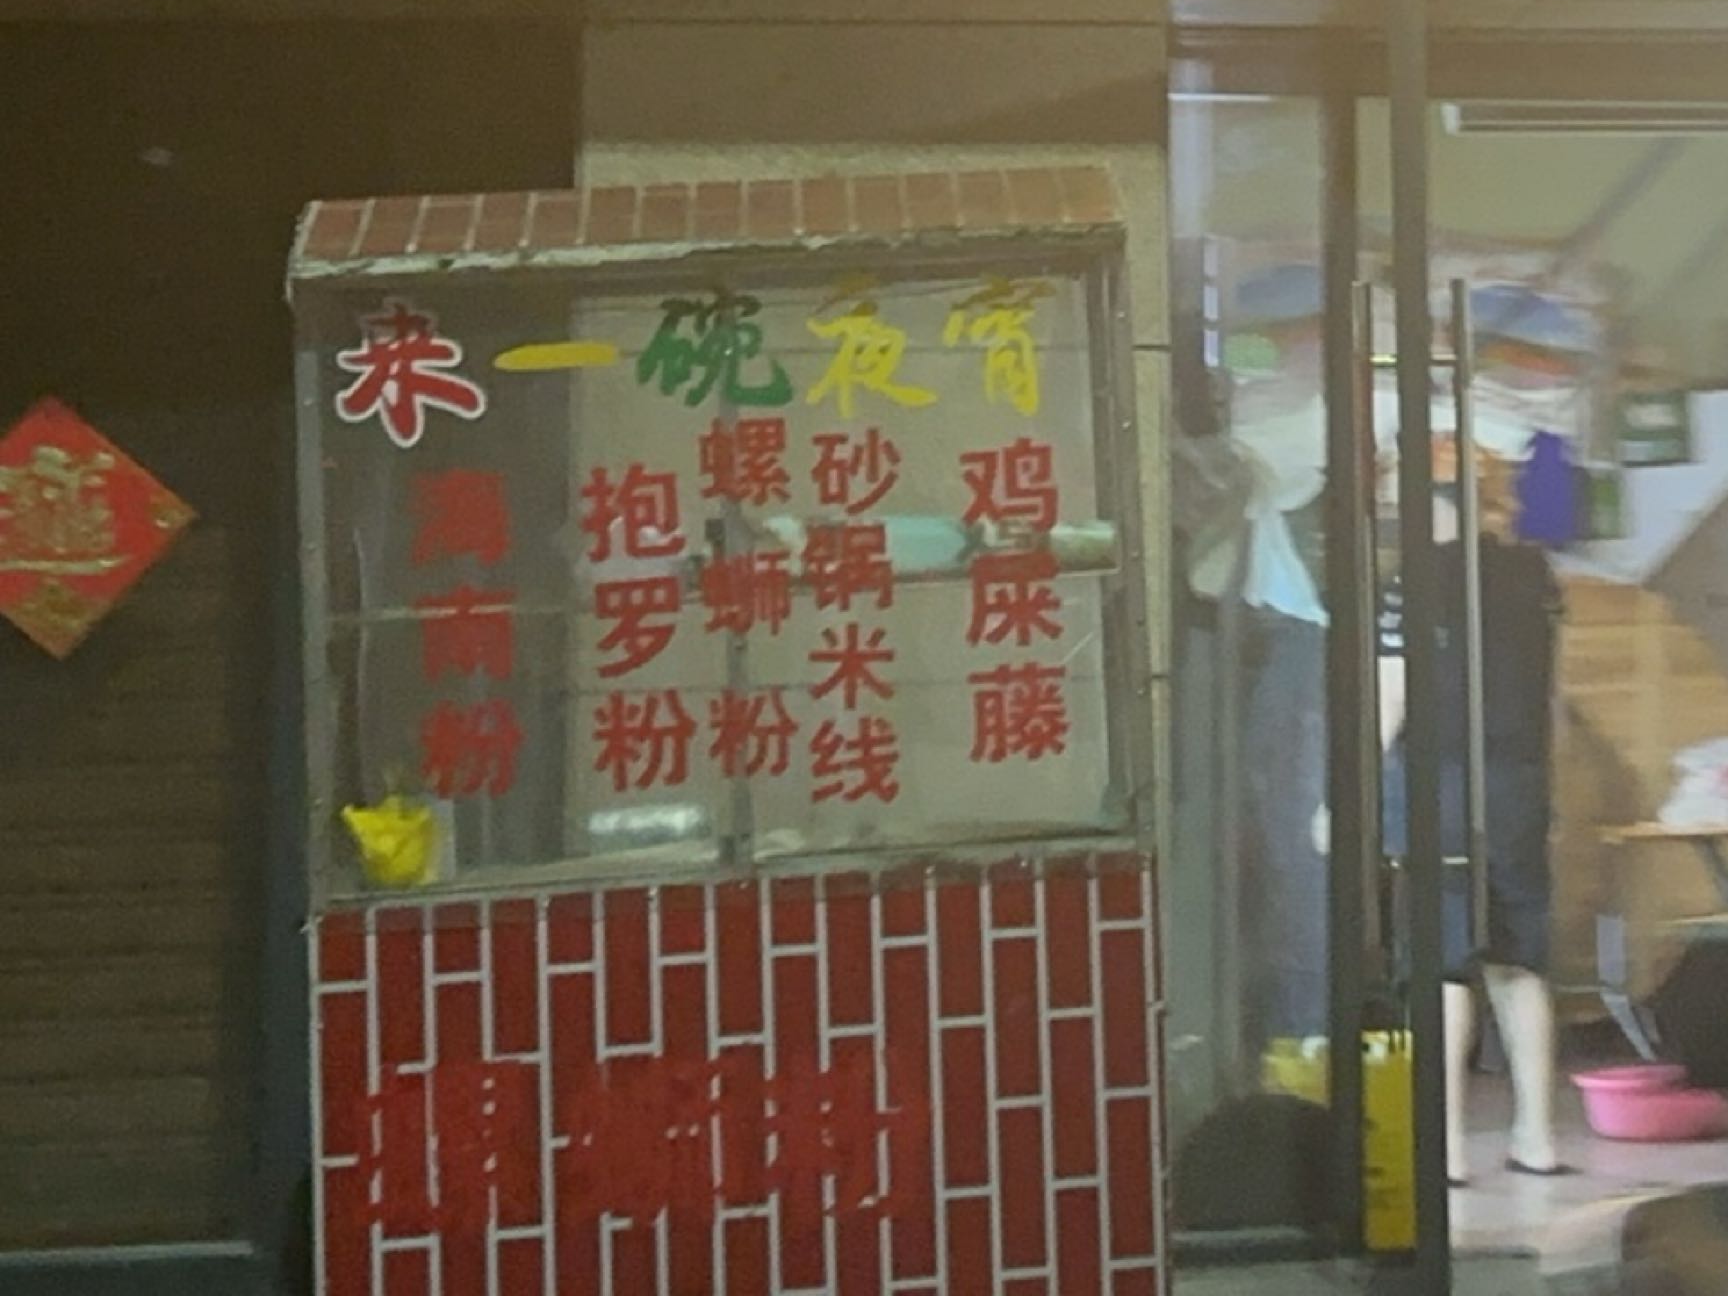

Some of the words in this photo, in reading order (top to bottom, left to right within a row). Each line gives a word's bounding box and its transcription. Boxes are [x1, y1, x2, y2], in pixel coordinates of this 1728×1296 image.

[582, 463, 697, 792] 抱罗粉
[697, 416, 800, 781] 螺蛳粉
[801, 429, 903, 805] 砂锅米线
[960, 438, 1069, 764] 鸡屎藤
